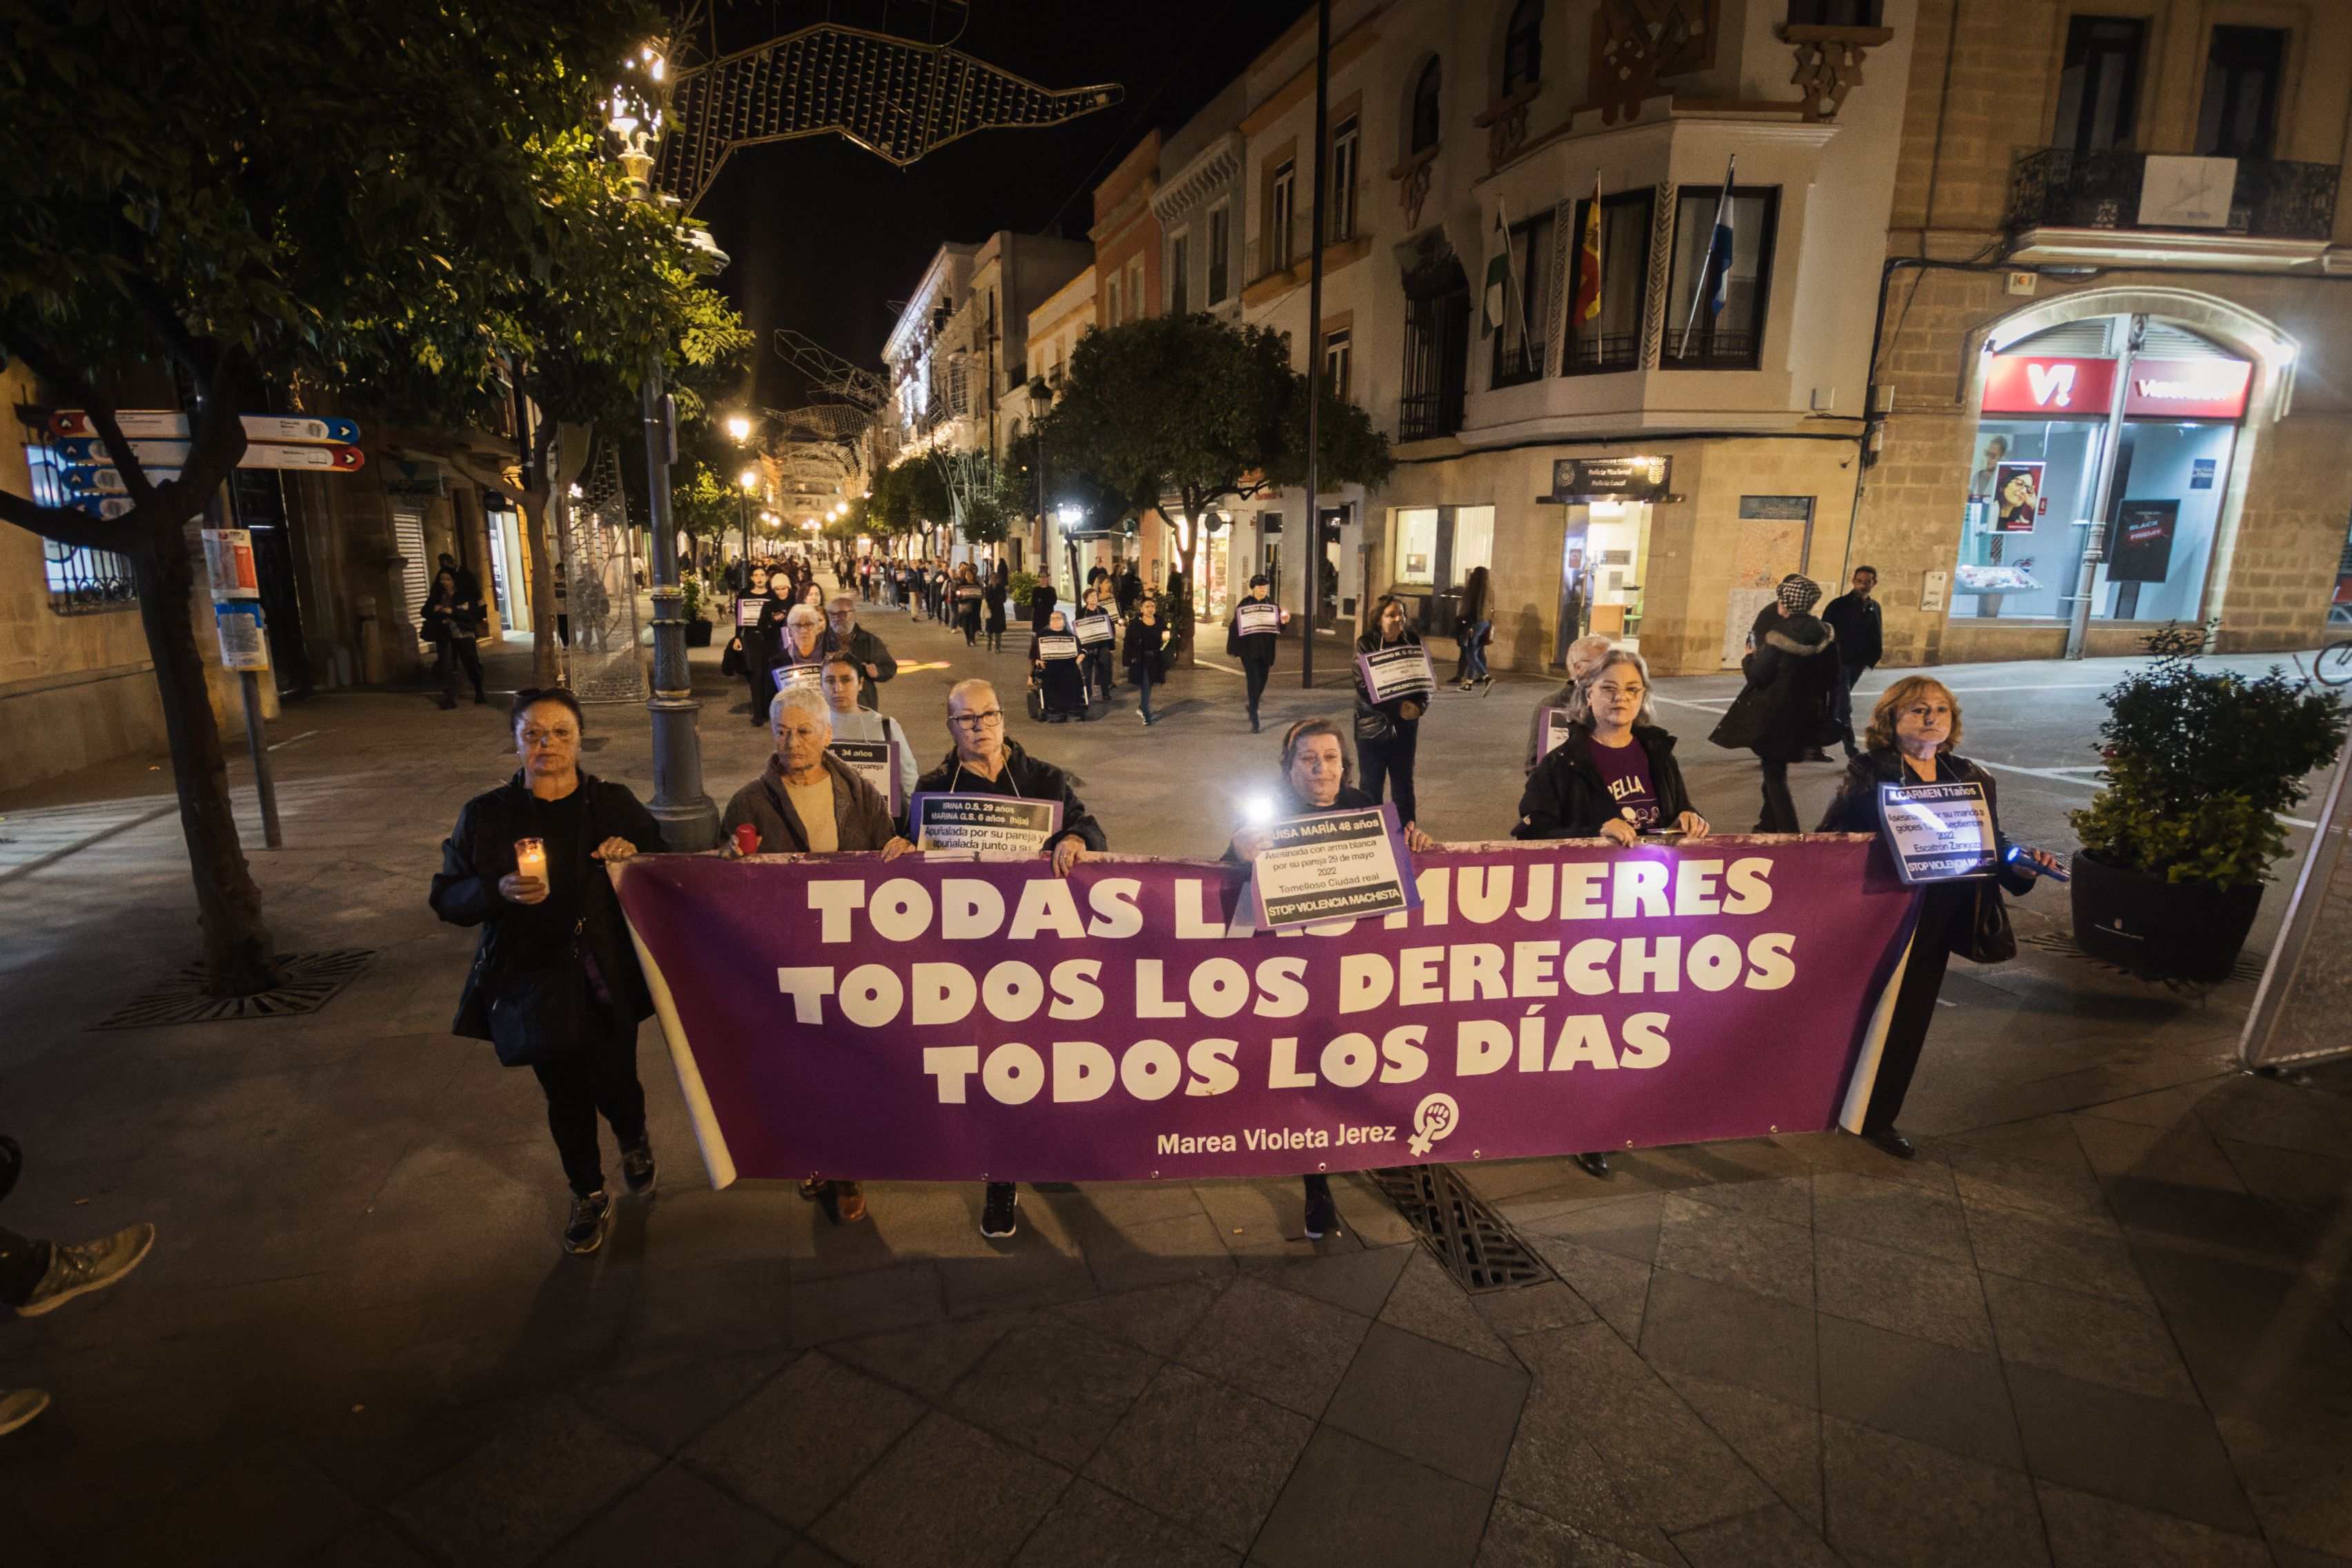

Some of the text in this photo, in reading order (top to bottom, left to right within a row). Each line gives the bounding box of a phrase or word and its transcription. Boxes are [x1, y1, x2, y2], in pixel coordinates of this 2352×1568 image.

[2128, 520, 2158, 531] BLACK
[2130, 529, 2162, 540] FRIDAY
[965, 803, 980, 811] D.S.
[994, 804, 1015, 813] años
[1888, 814, 1921, 822] Asesina
[1954, 808, 1979, 817] marido
[960, 812, 977, 821] G.S.
[986, 814, 1006, 823] años
[1010, 816, 1030, 826] (hija)
[925, 826, 1045, 843] Apuñalada por su pareja y
[1271, 819, 1380, 840] UISA MARÍA 48 años
[1896, 823, 1922, 834] golpes
[1944, 820, 1984, 830] septiembre
[933, 839, 979, 850] apuñalada
[981, 841, 1008, 851] junto
[1265, 848, 1309, 860] Asesinada
[1327, 843, 1348, 852] arma
[1349, 839, 1377, 850] blanca
[1914, 841, 1981, 852] Escatrón Zaragoza
[1273, 863, 1287, 872] por
[1302, 858, 1326, 869] pareja
[1352, 852, 1375, 861] mayo
[1908, 862, 1929, 872] STOP
[1317, 868, 1337, 876] 2022
[1279, 873, 1380, 894] Tomelloso Ciudad real
[1268, 888, 1401, 917] STOP VIOLENCIA MACHISTA
[807, 878, 1144, 943] TODAS
[777, 932, 1796, 1028] TODOS LOS DERECHOS
[923, 1005, 1671, 1105] TODOS LOS DÍAS
[1157, 1124, 1396, 1155] Marea Violeta Jerez
